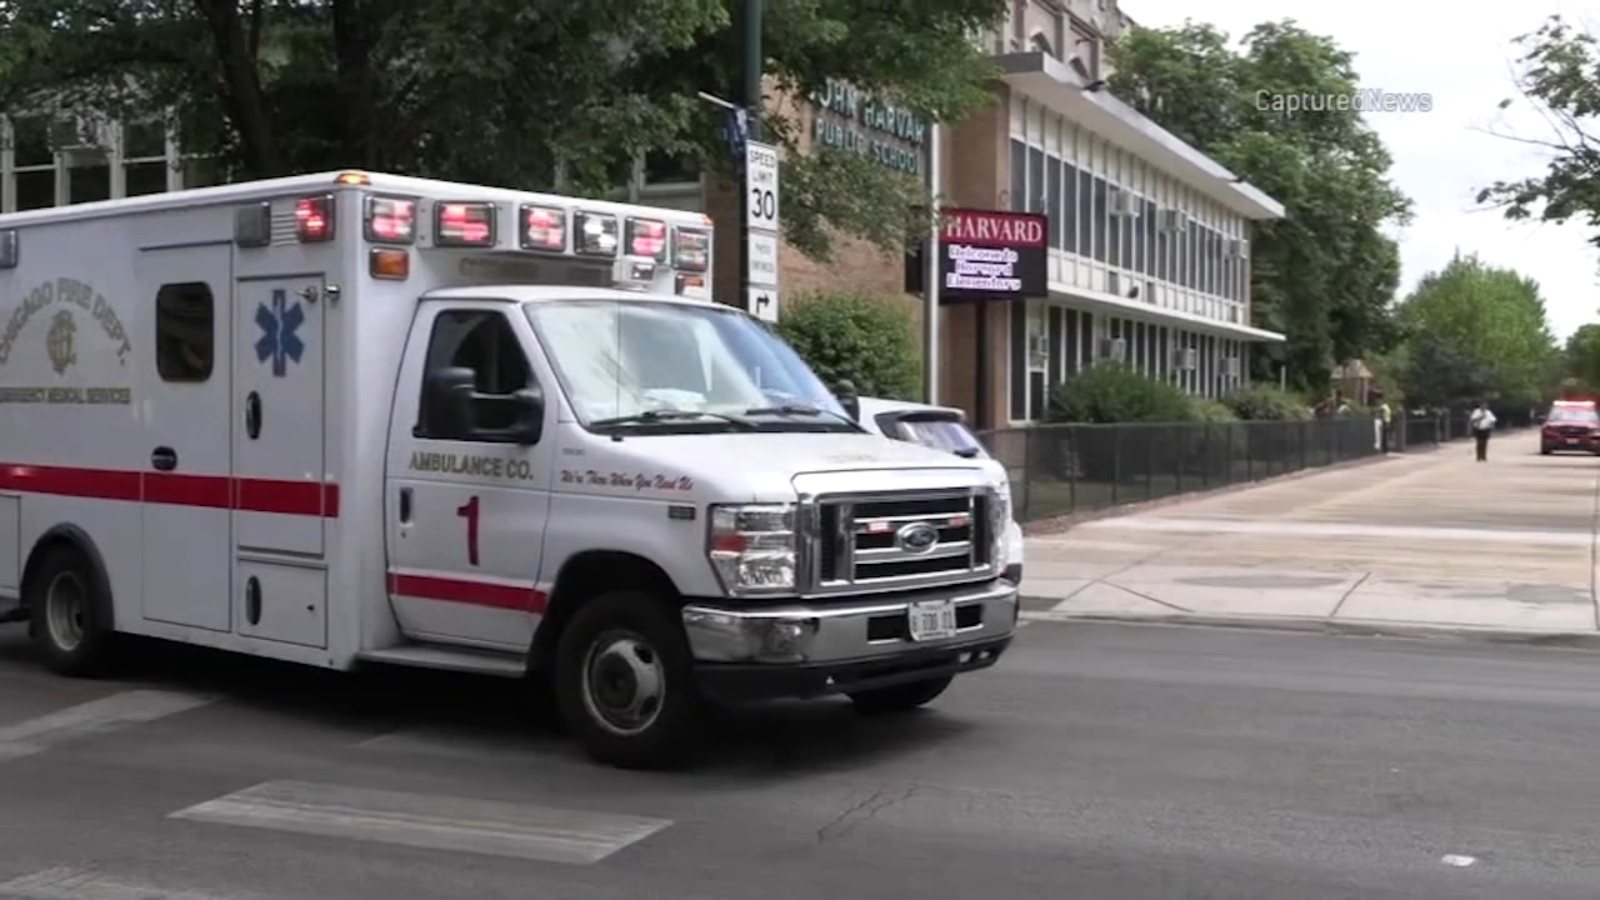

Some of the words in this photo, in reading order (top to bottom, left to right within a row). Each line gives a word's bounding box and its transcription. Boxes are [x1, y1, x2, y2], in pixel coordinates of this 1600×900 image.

[749, 149, 775, 168] SPEED
[752, 171, 774, 184] LIMIT
[751, 187, 775, 220] 30
[946, 215, 1042, 242] HARVARD
[0, 281, 53, 366] CHICAGO
[57, 277, 93, 310] FIRE
[86, 387, 131, 404] SERVICES
[409, 451, 503, 479] AMBULANCE
[505, 458, 535, 480] CO.
[456, 495, 480, 567] 1
